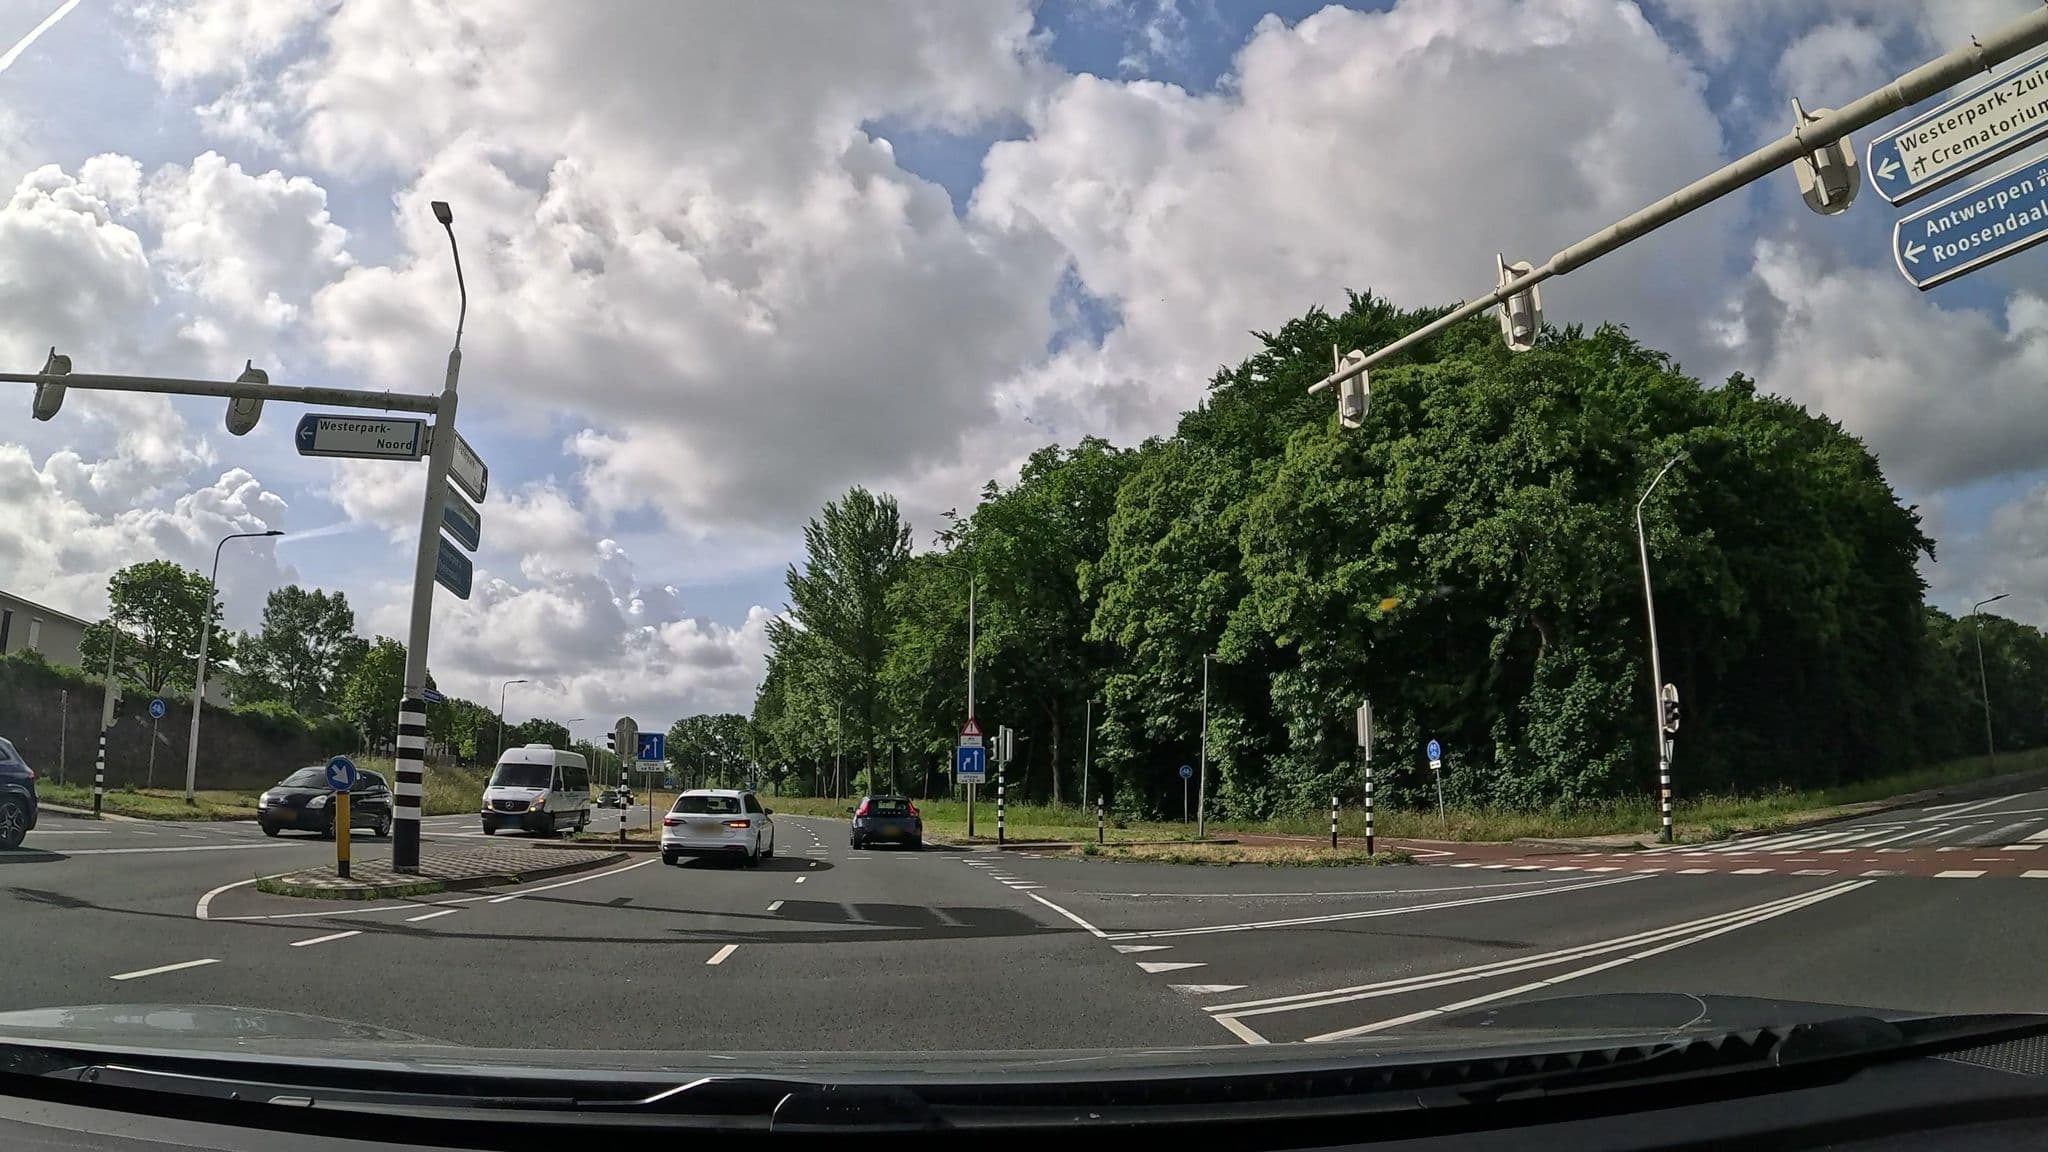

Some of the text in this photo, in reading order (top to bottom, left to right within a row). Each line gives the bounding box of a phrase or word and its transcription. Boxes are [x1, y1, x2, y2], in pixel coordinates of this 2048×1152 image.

[1926, 178, 2034, 238] Antwerpen
[1932, 199, 2048, 263] Roosendaal
[319, 420, 391, 434] Westerpark-
[376, 438, 414, 451] Noord
